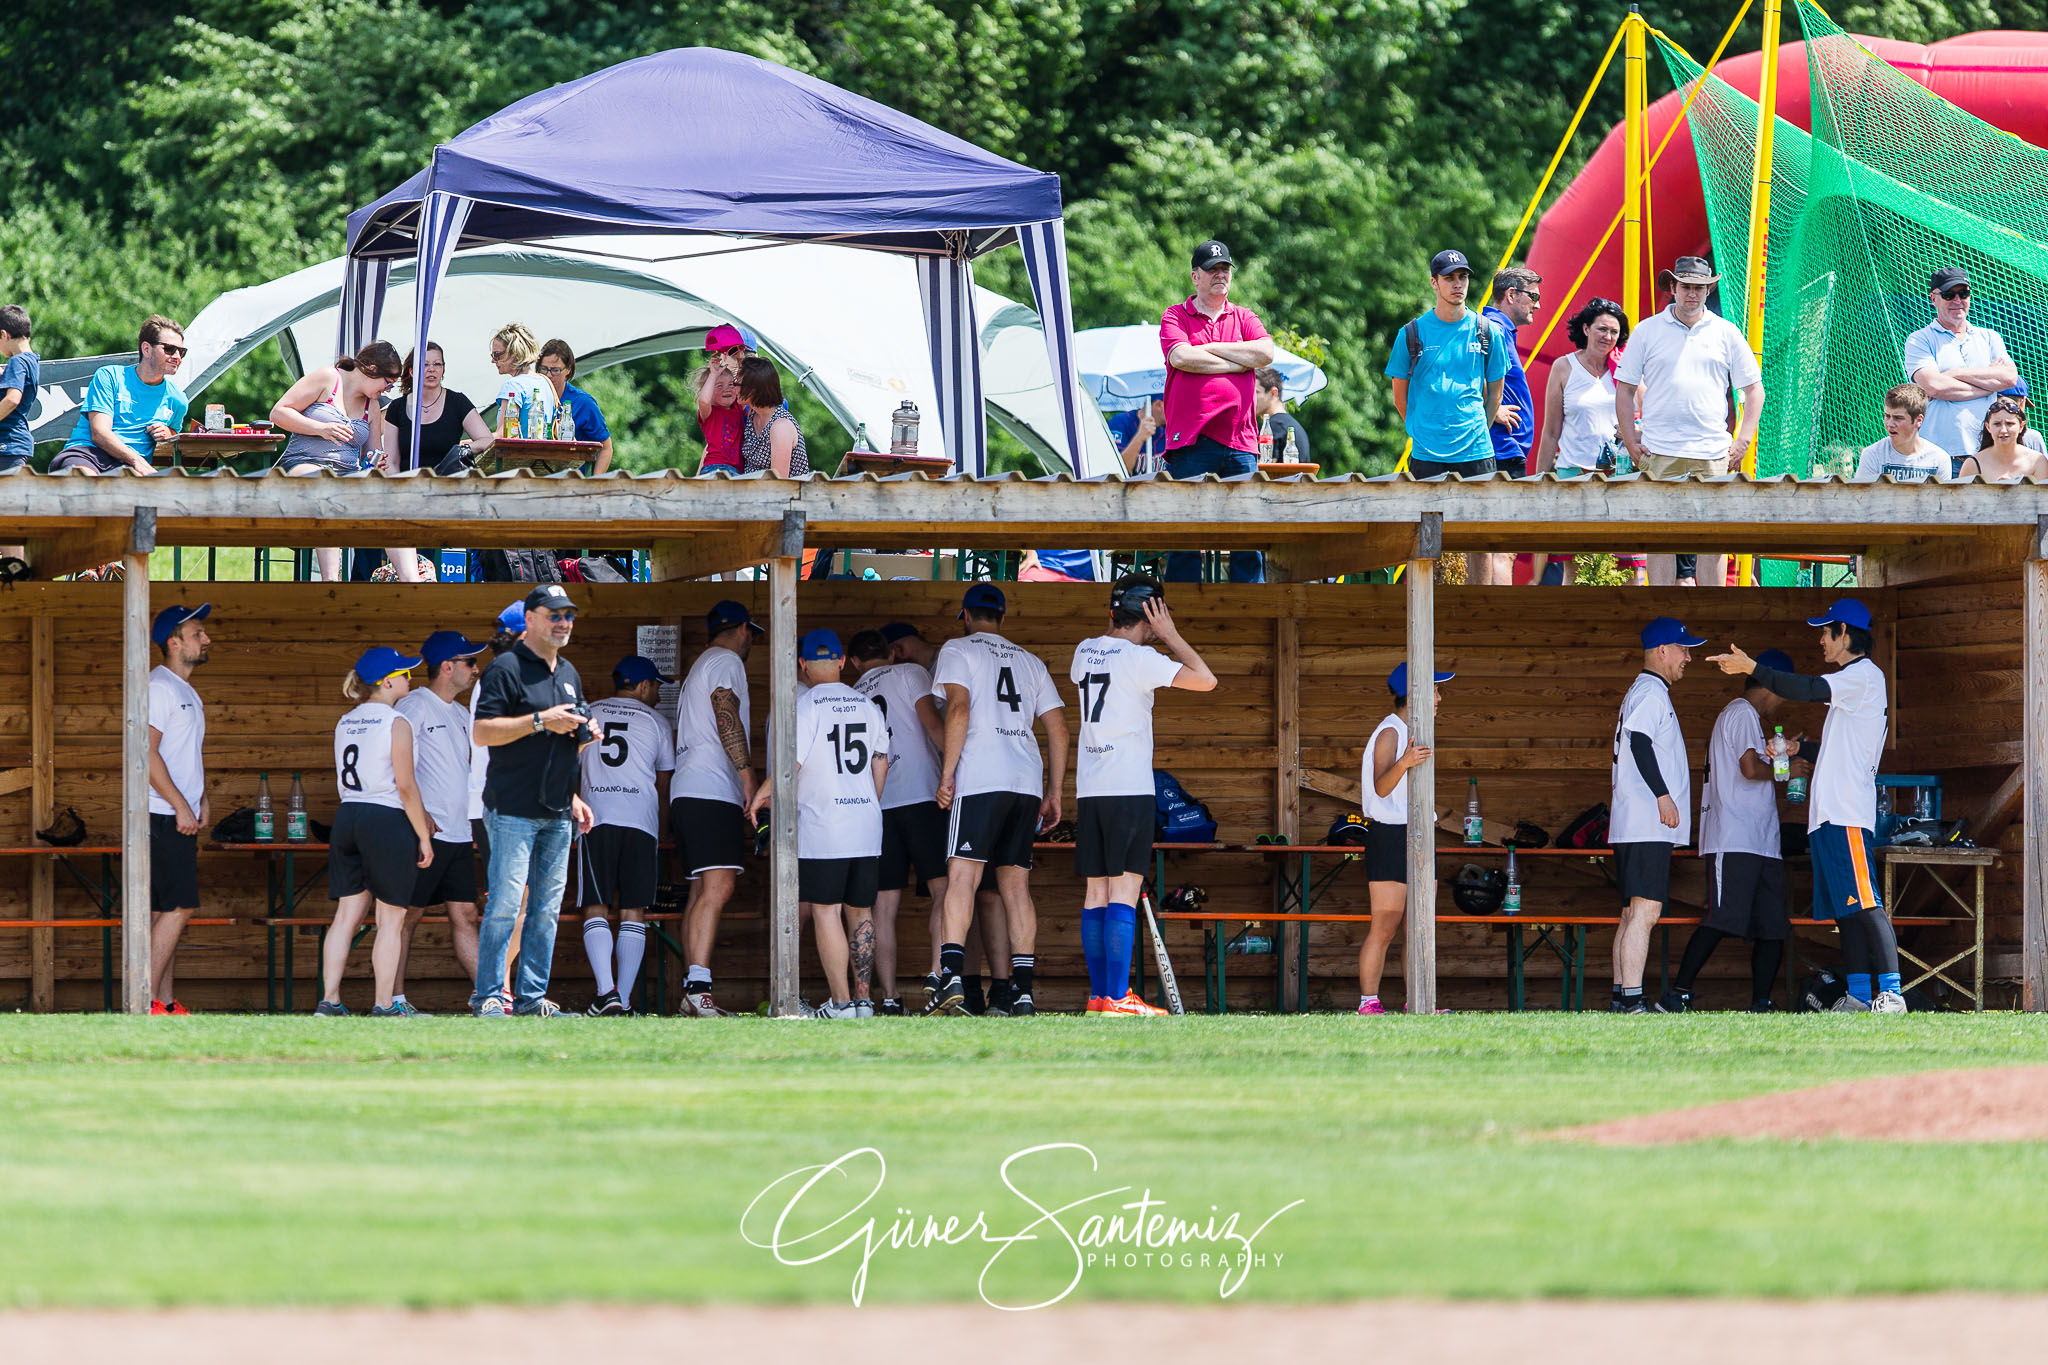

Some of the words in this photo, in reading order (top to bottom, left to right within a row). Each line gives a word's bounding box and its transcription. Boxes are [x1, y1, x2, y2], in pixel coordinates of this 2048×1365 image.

[1210, 244, 1222, 257] R
[602, 707, 617, 716] Cup
[996, 666, 1022, 713] 4
[1078, 671, 1111, 723] 17
[341, 743, 363, 792] 8
[600, 721, 629, 768] 5
[826, 722, 868, 775] 15
[590, 785, 621, 793] TADANO
[1158, 953, 1182, 1015] EASTON
